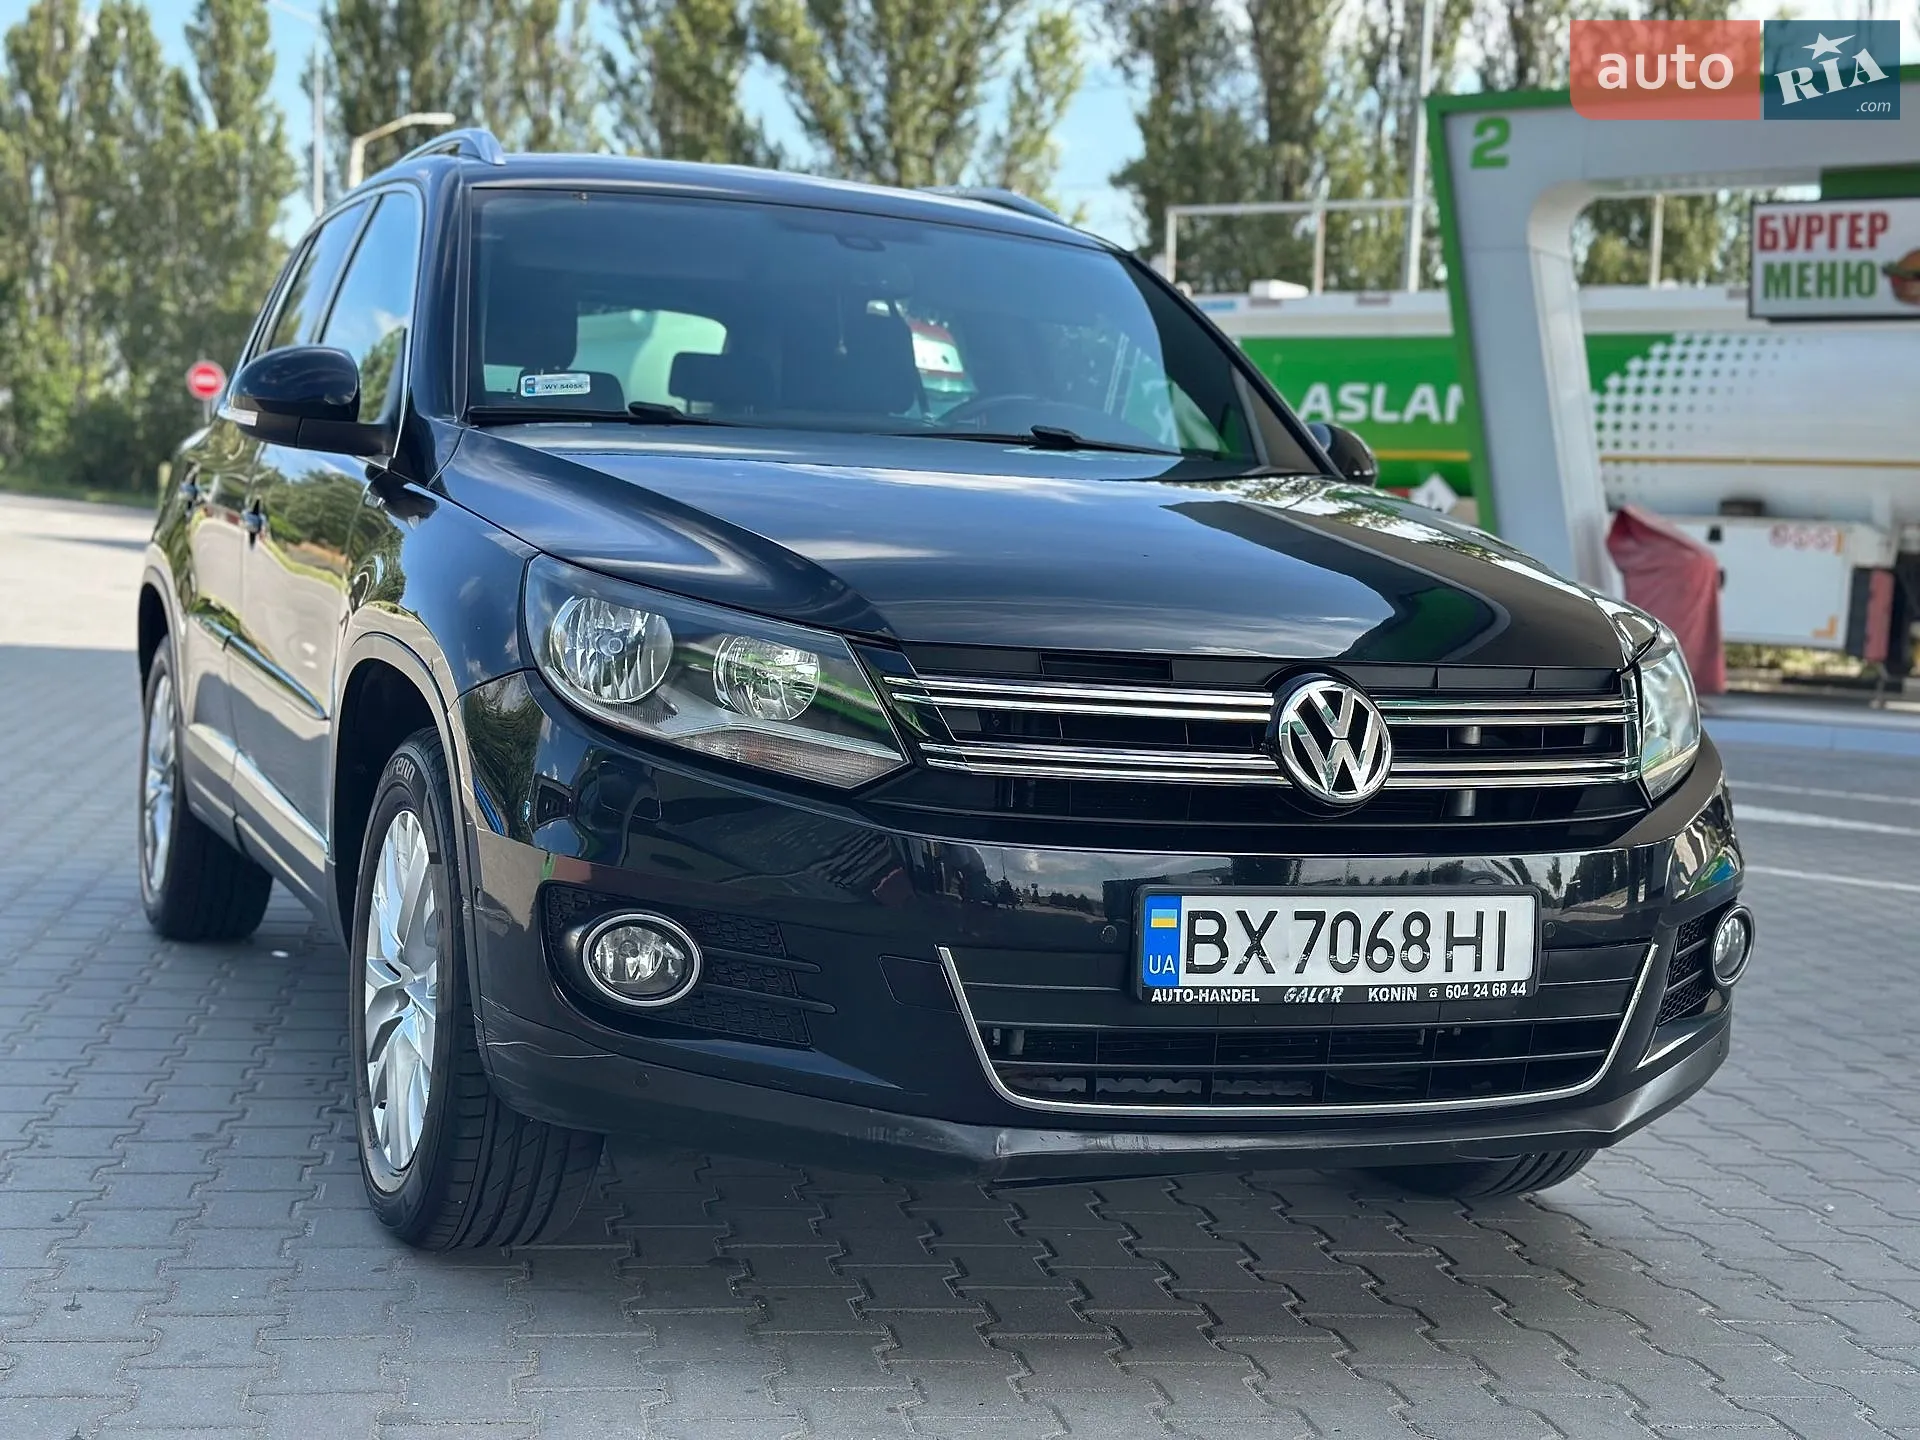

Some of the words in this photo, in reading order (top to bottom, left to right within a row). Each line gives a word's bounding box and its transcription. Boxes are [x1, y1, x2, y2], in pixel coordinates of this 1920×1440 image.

[1470, 117, 1511, 170] 2
[1758, 212, 1889, 251] БУРГЕР
[1764, 261, 1876, 299] МЕНЮ
[1185, 910, 1279, 975] BX
[1293, 910, 1431, 974] 7068
[1445, 910, 1507, 972] HI
[1149, 954, 1176, 975] UA
[1151, 987, 1260, 1003] AUTO-HANDEL
[1445, 984, 1469, 999] 604
[1473, 983, 1488, 998] 24
[1492, 982, 1507, 997] 68
[1511, 981, 1527, 996] 44
